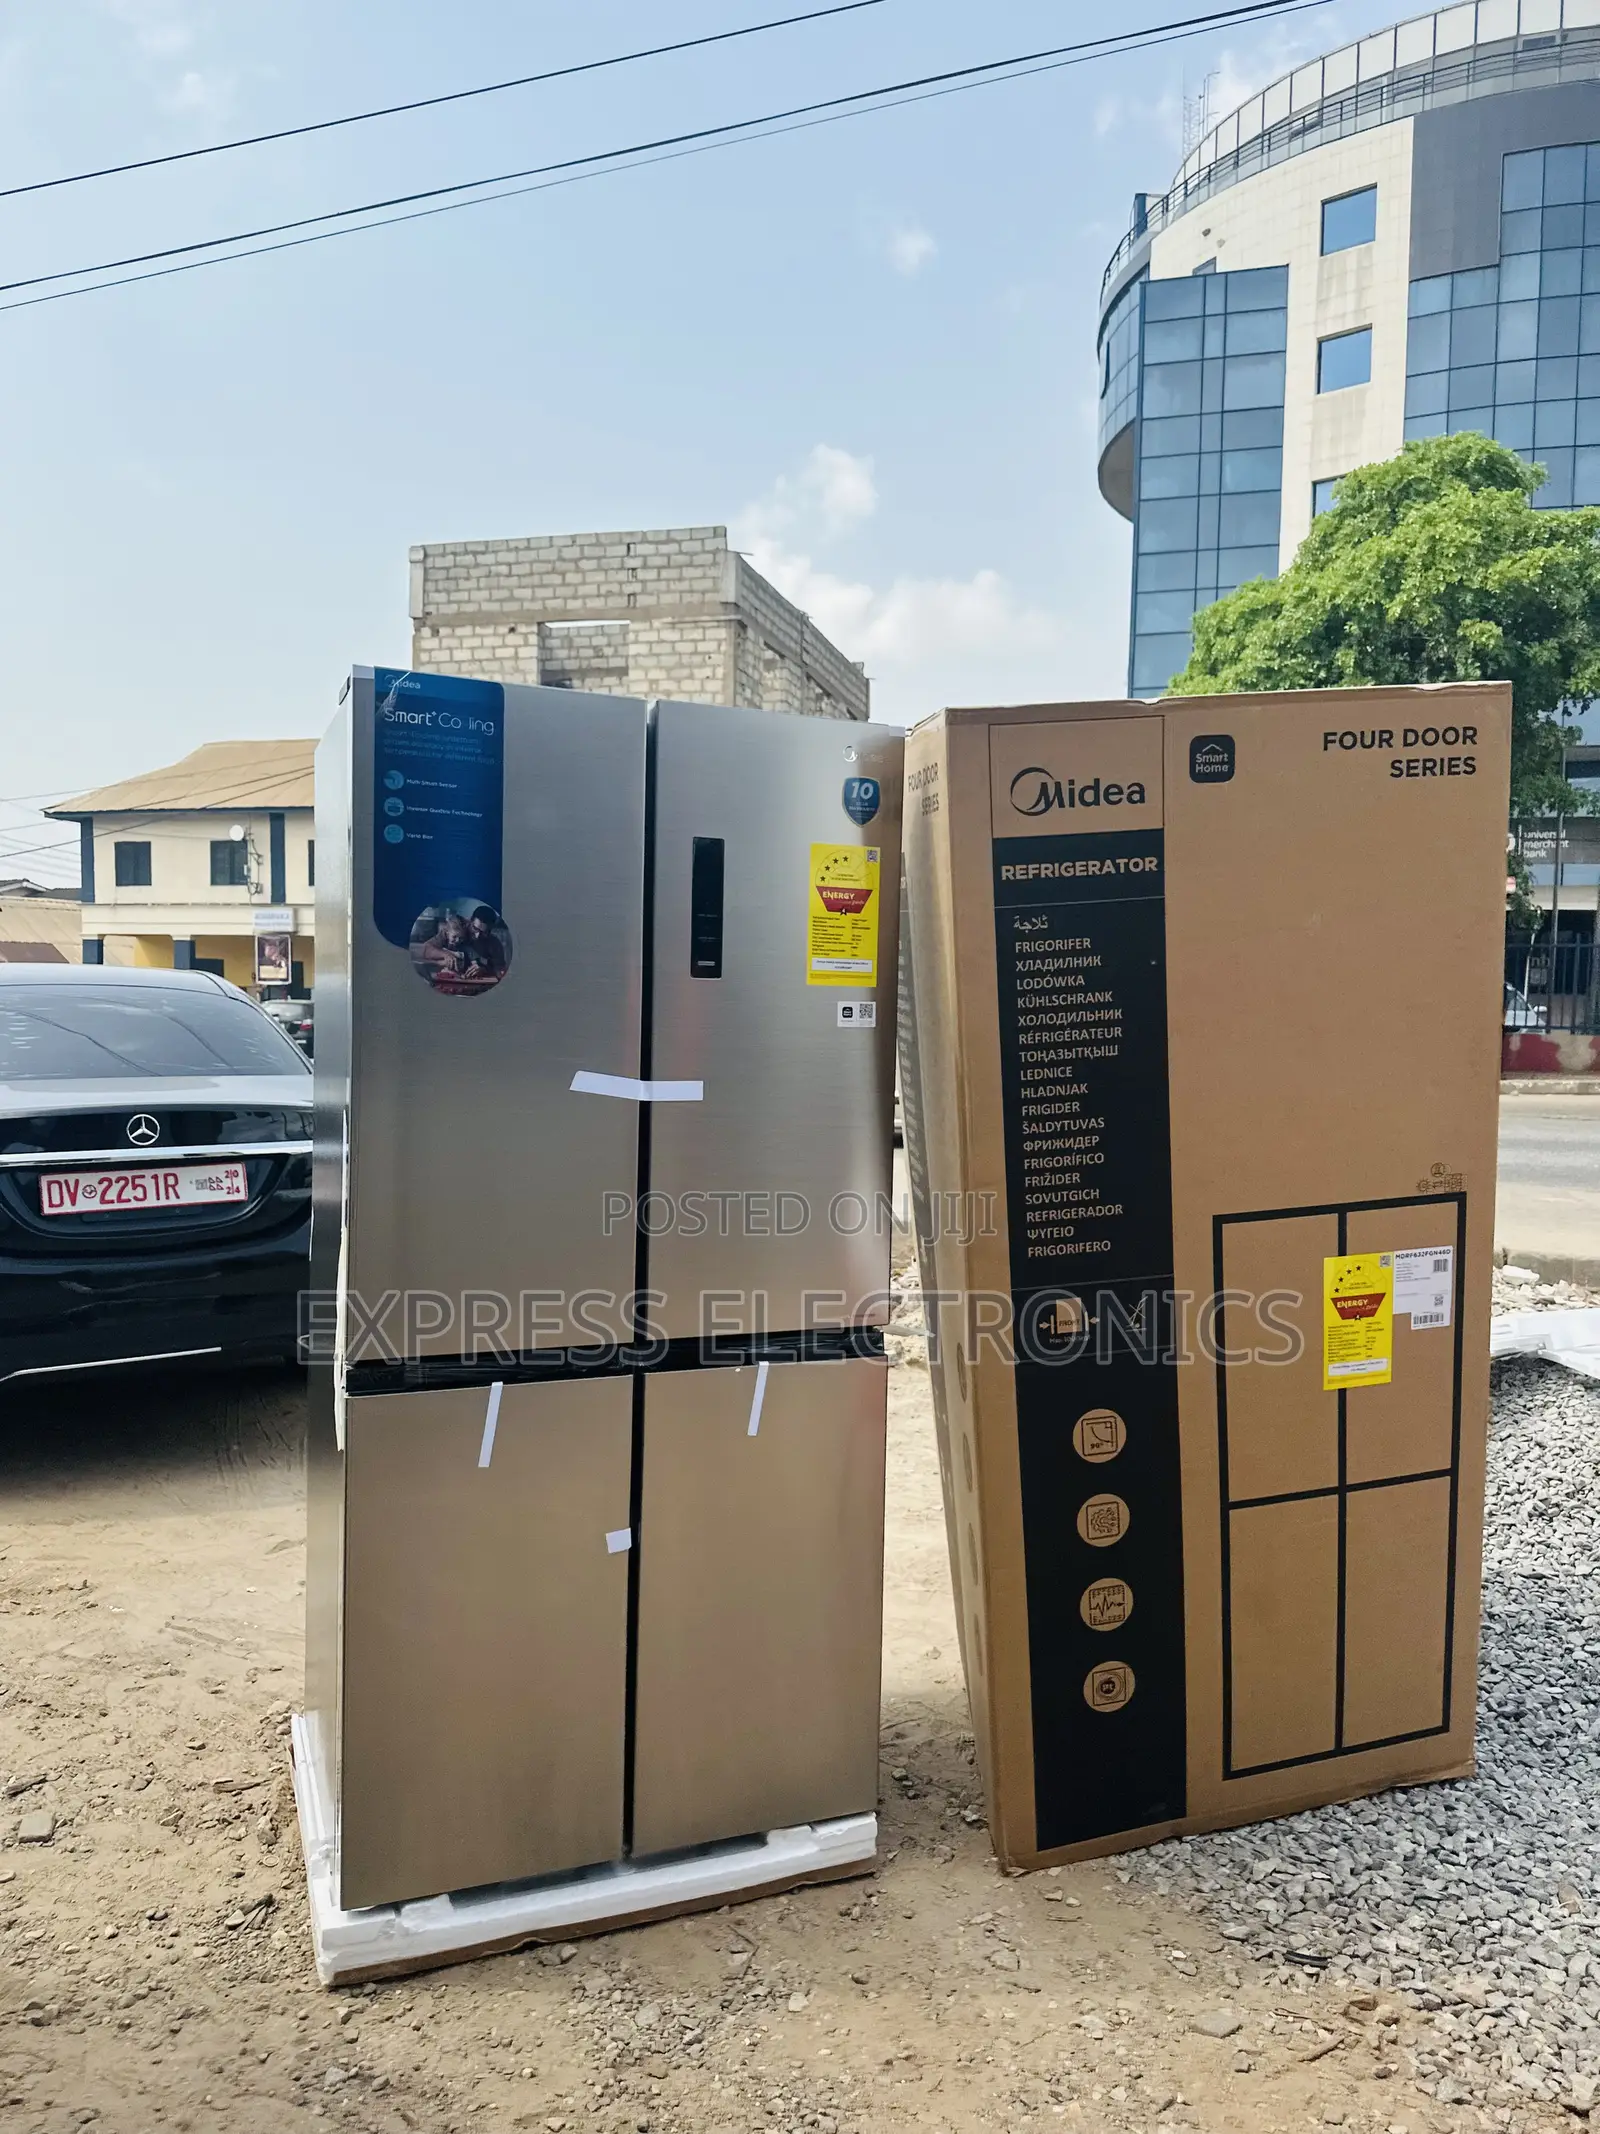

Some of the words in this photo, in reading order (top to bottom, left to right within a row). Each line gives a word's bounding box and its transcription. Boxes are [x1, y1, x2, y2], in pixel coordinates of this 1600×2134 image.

[438, 712, 495, 736] Coling
[1323, 729, 1394, 751] FOUR
[1402, 726, 1478, 748] DOOR
[1195, 752, 1229, 764] Smart
[1195, 763, 1230, 774] Home
[1389, 757, 1477, 779] SERIES
[907, 769, 922, 792] FOUR
[922, 762, 939, 787] DOOR
[851, 781, 874, 800] 10
[1010, 767, 1146, 817] Midea
[1523, 848, 1547, 858] bank
[1001, 857, 1158, 881] REFRIGERATOR
[822, 890, 855, 900] ENERGY
[1013, 914, 1049, 933] ثلاجة
[1015, 938, 1091, 953] FRIGORIFER
[1015, 955, 1102, 972] ХЛАДИЛНИК
[1016, 974, 1085, 990] LODÓWKA
[1017, 991, 1113, 1008] KÜHLSCHRANK
[1018, 1008, 1123, 1026] ХОЛОДИЛЬНИК
[1019, 1026, 1123, 1045] RÉFRIGÉRATEUR
[1020, 1066, 1073, 1081] LEDNICE
[1021, 1083, 1089, 1099] HLADNJAK
[1021, 1101, 1081, 1117] FRIGIDER
[1022, 1117, 1105, 1134] ŠALDYTUVAS
[1023, 1135, 1100, 1152] ФРИЖИДЕР
[1024, 1152, 1105, 1170] FRIGORÍFICO
[1025, 1172, 1081, 1188] FRIŽIDER
[46, 1179, 79, 1208] DV
[98, 1172, 181, 1205] 2251R
[1025, 1188, 1100, 1205] SOVUTGICH
[1026, 1204, 1124, 1223] REFRIGERADOR
[1028, 1240, 1111, 1258] FRIGORIFERO
[1336, 1298, 1369, 1309] ENERGY
[1059, 1318, 1081, 1327] FROT
